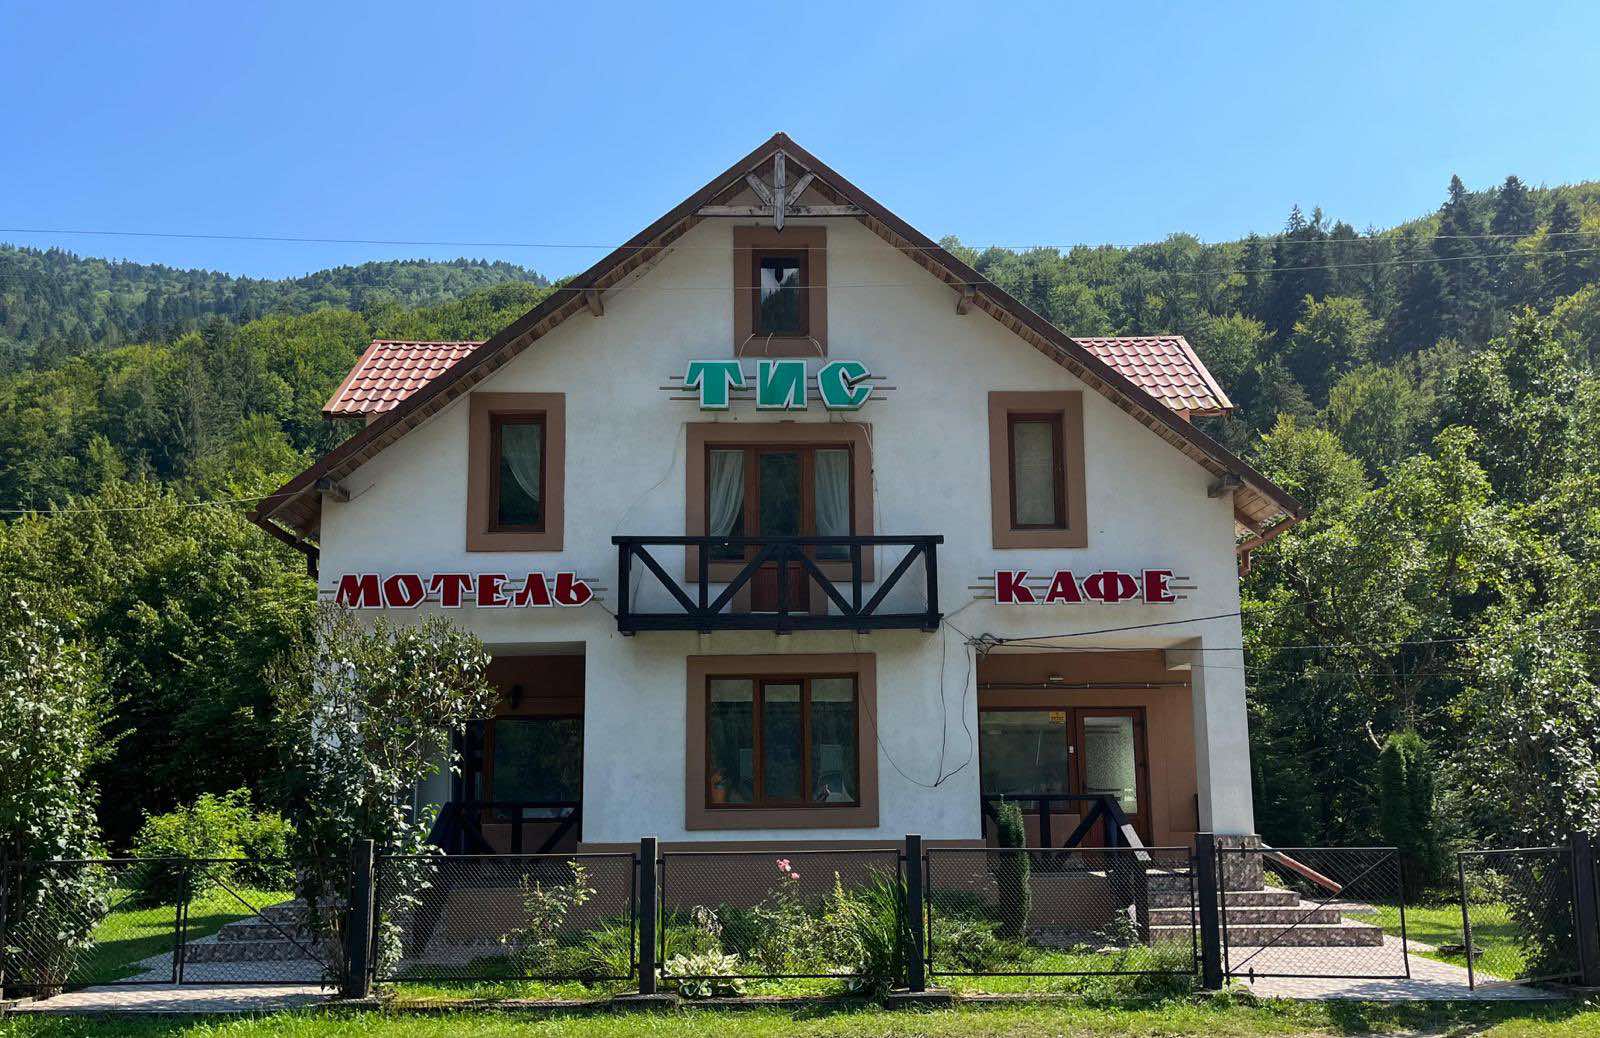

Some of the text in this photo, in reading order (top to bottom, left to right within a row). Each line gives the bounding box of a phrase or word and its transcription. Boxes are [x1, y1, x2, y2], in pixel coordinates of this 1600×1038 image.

[684, 360, 874, 410] ТИС
[335, 572, 594, 608] МОТЕЛЬ
[995, 569, 1178, 604] КАФЕ
